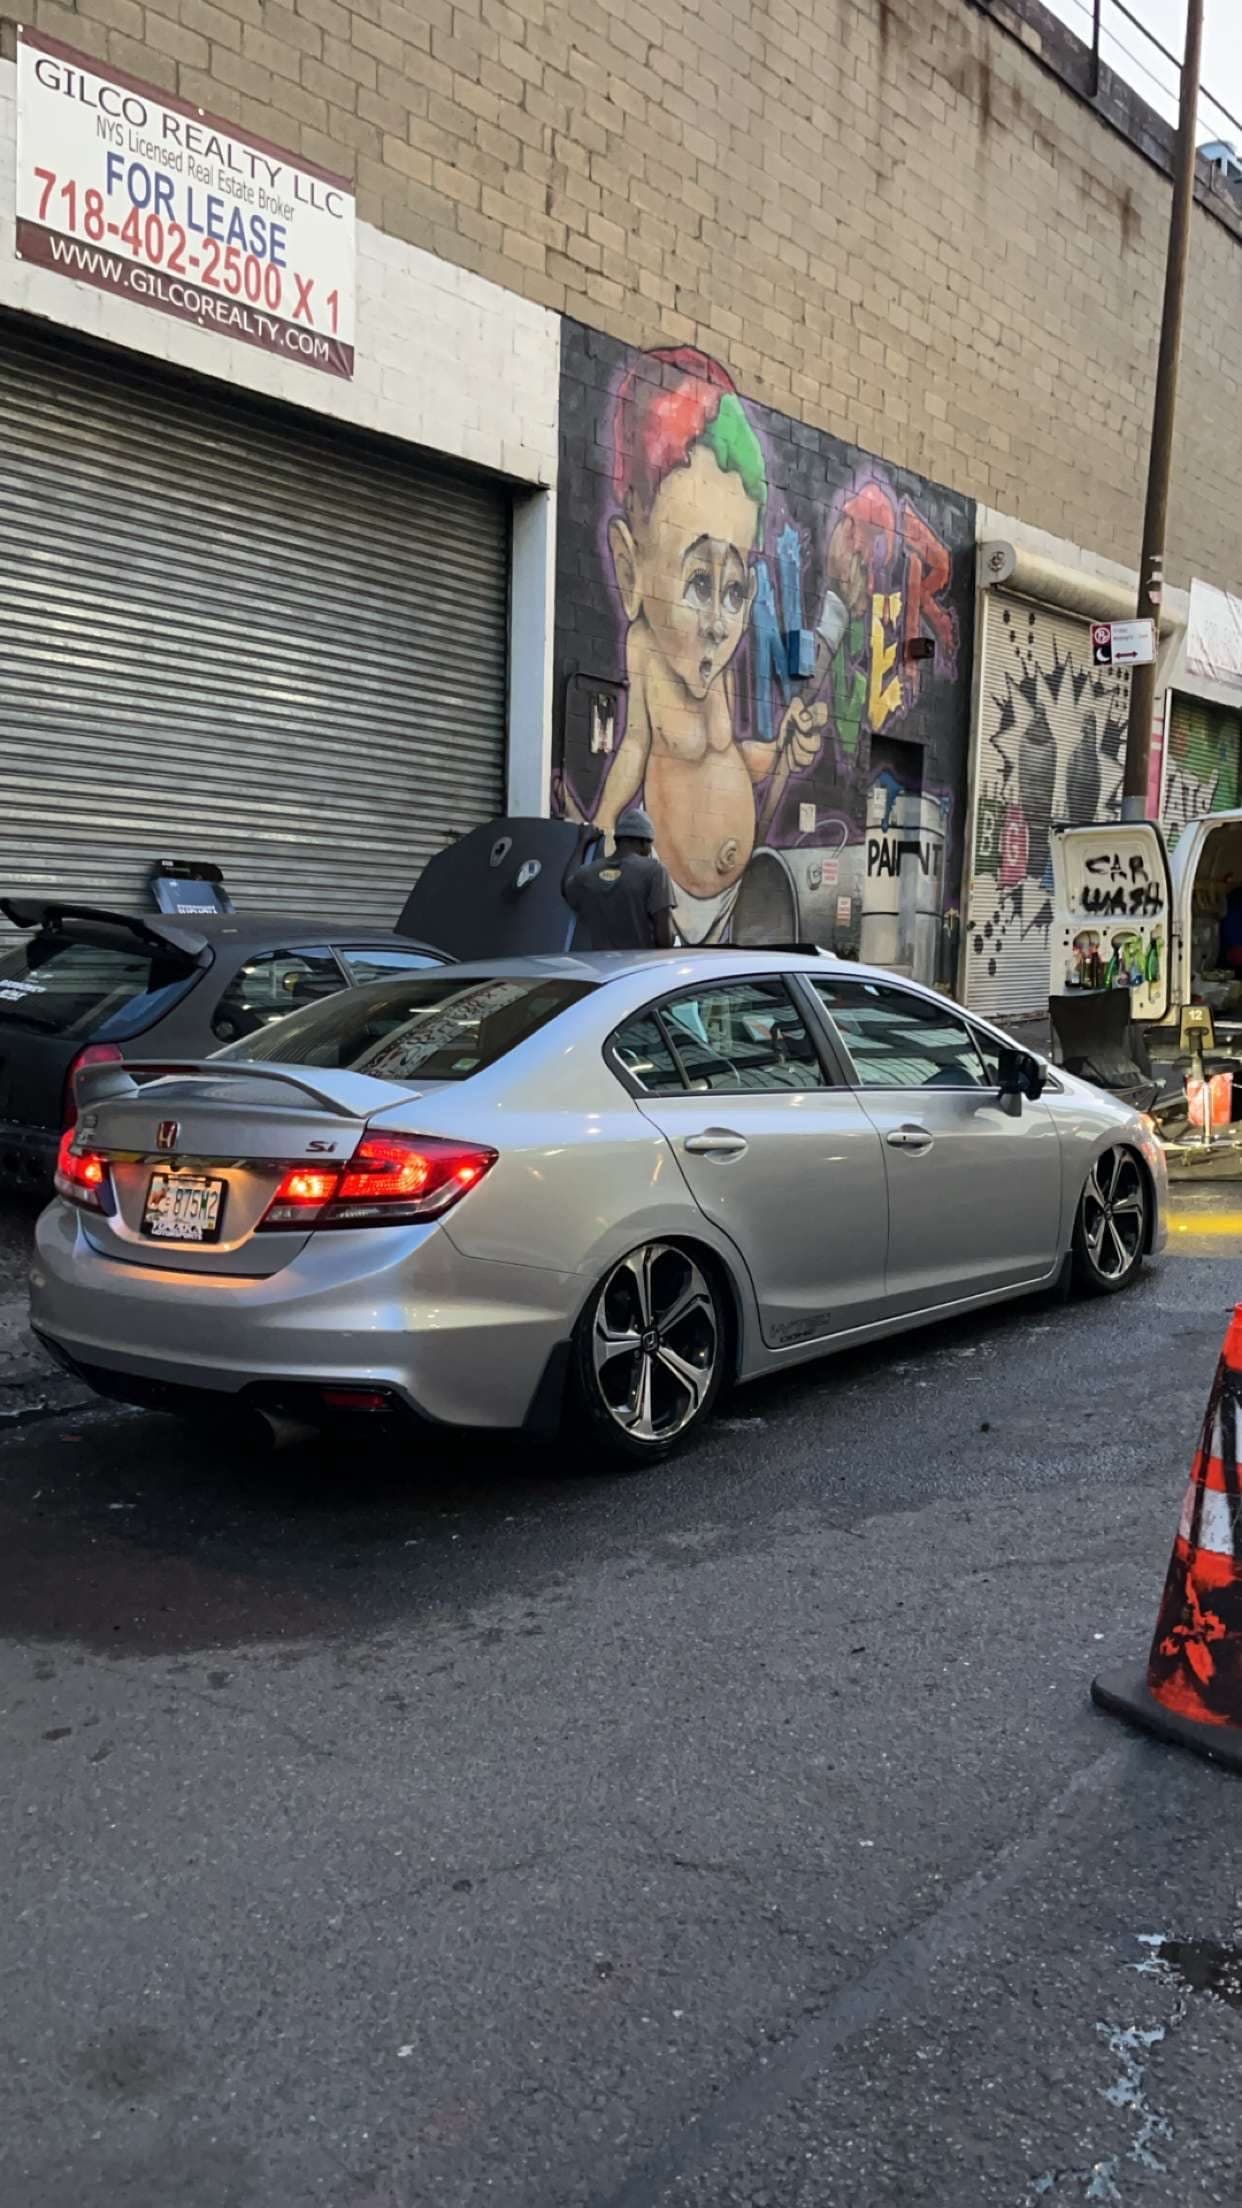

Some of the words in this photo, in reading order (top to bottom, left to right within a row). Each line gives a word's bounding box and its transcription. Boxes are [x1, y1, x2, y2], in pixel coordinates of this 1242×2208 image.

[35, 59, 148, 127] GILCO
[162, 113, 282, 189] REALTY
[294, 174, 345, 218] LLC
[96, 115, 125, 147] NYS
[129, 129, 183, 174] Licensed
[188, 154, 214, 185] Real
[218, 171, 255, 205] Estate
[259, 189, 295, 222] Broker
[34, 166, 282, 311] 718-402-2500
[293, 273, 314, 326] X
[326, 289, 340, 334] 1
[107, 151, 175, 222] FOR
[187, 186, 287, 268] LEASE
[50, 235, 330, 361] WWW.GILCOREALTY.COM
[1082, 881, 1164, 916] WASH
[1085, 853, 1148, 884] CAR
[1188, 1009, 1203, 1021] 12
